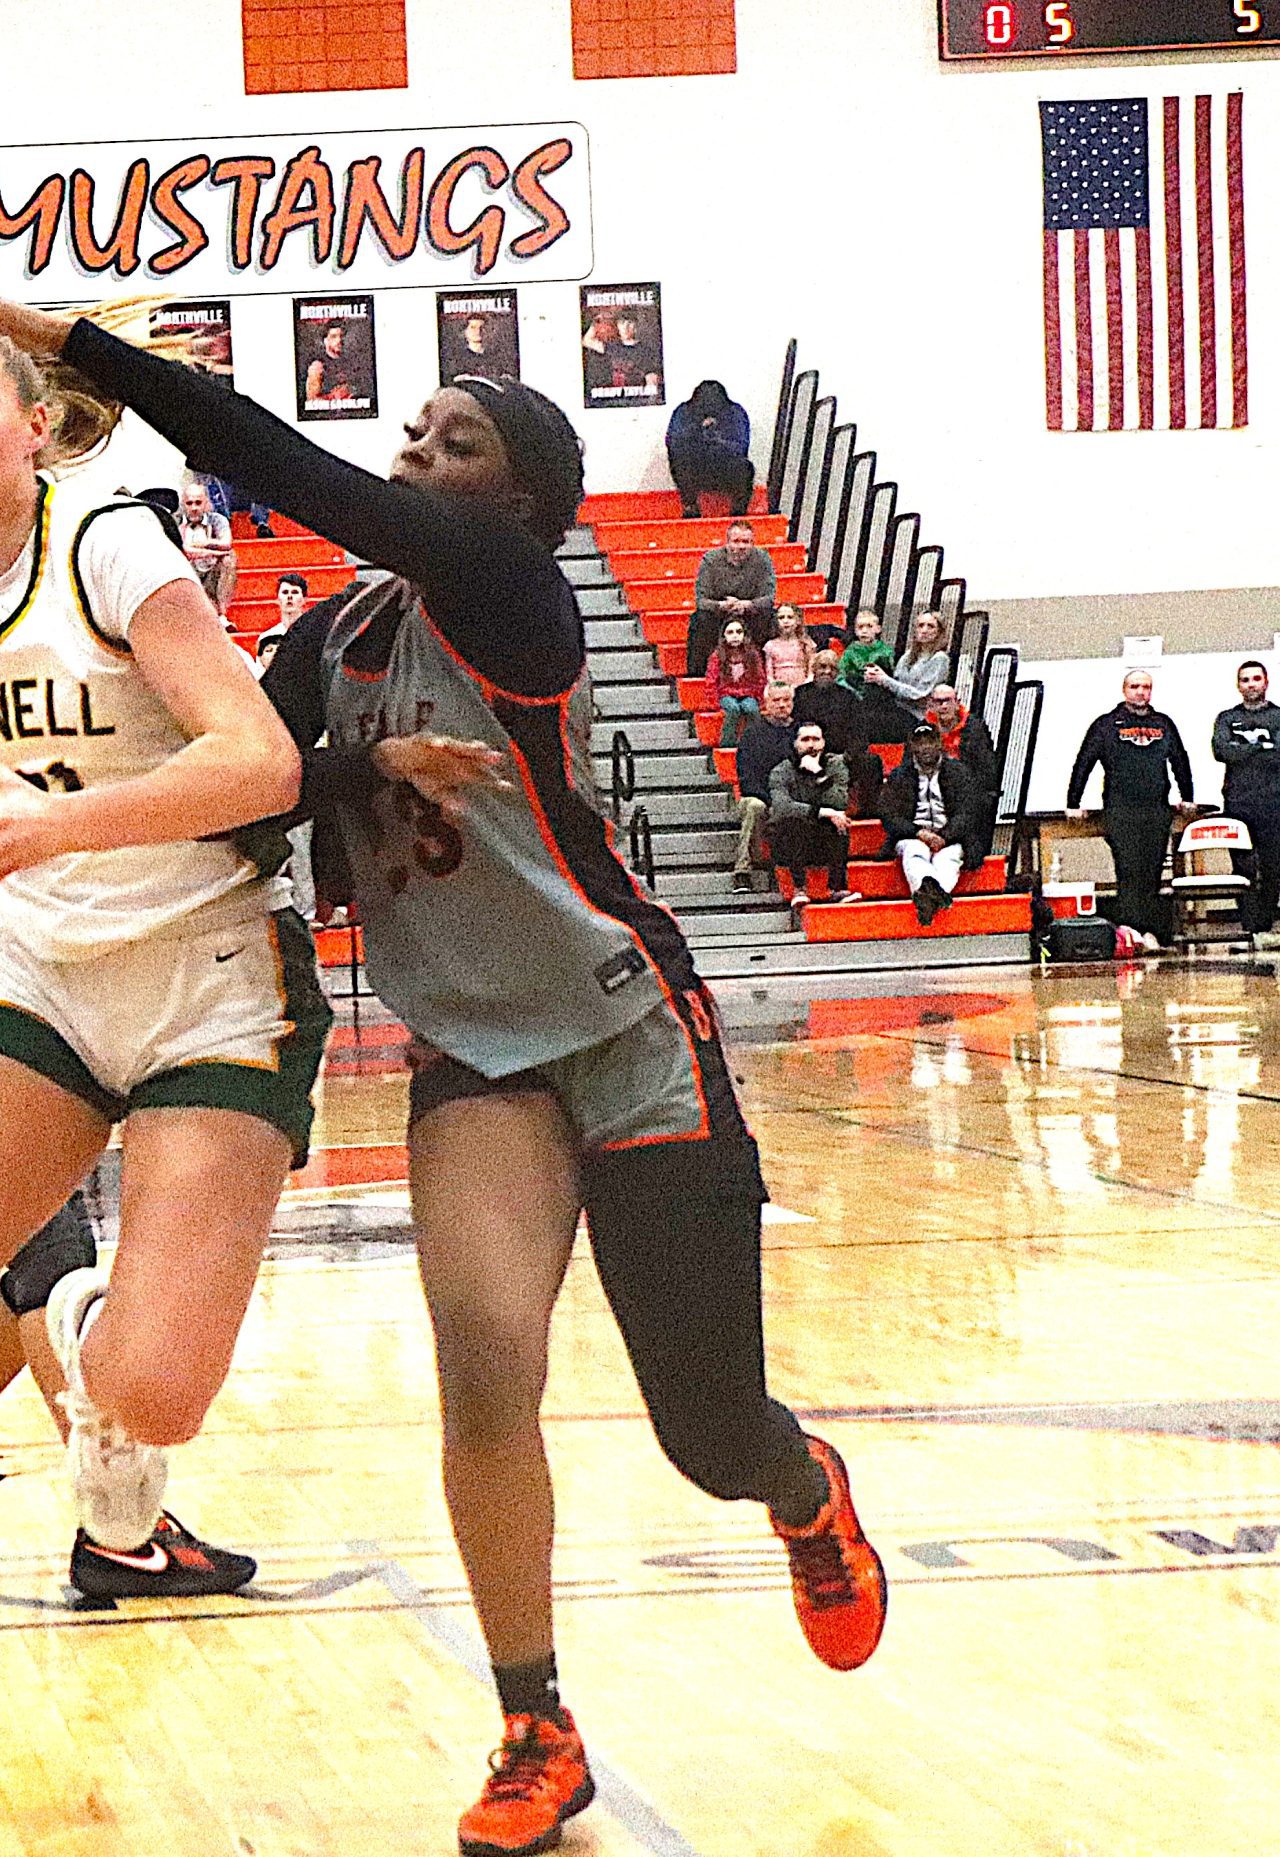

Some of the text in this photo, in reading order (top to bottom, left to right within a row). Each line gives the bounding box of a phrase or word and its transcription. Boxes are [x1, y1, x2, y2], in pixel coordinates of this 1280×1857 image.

[985, 2, 1072, 43] 0 5
[1233, 0, 1261, 33] 5
[443, 298, 511, 314] NORTHVILLE
[587, 290, 655, 307] NORTHVILLE
[300, 303, 368, 320] NORTHVILLE
